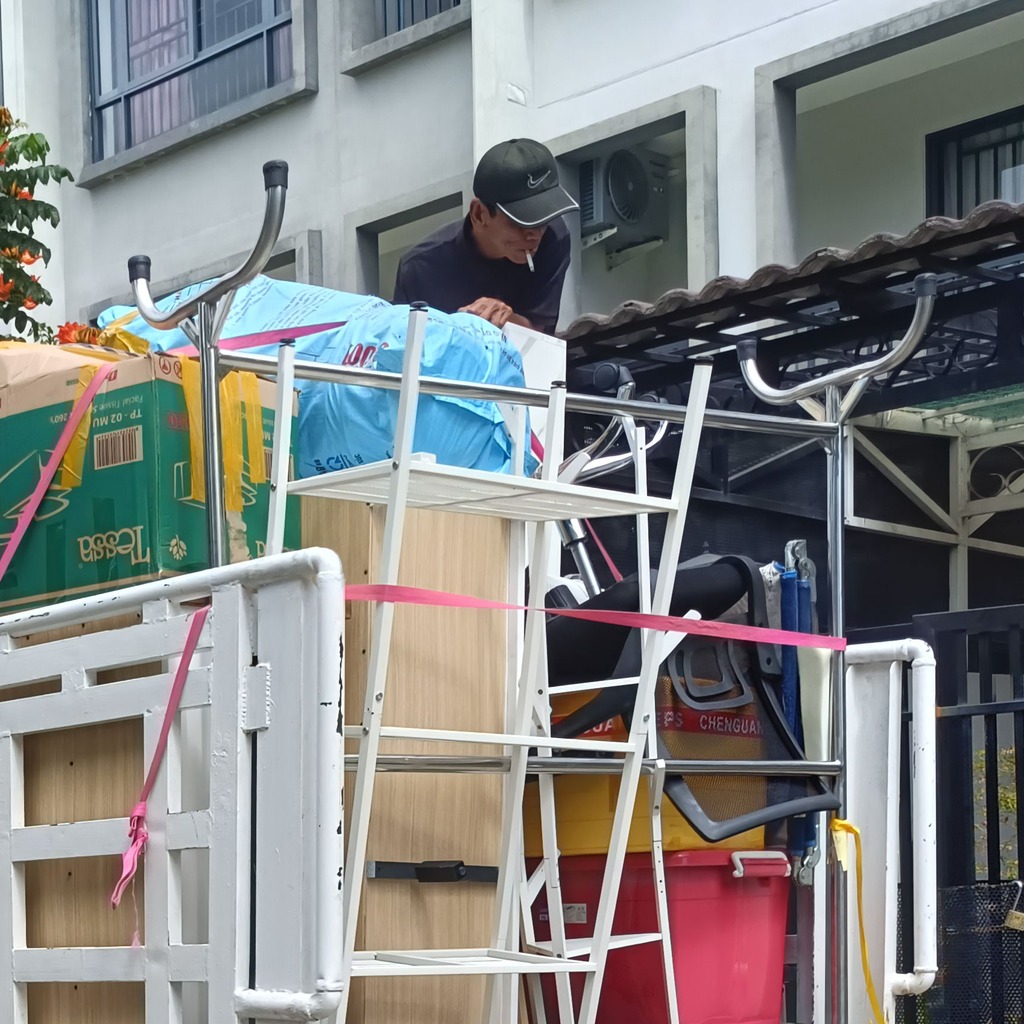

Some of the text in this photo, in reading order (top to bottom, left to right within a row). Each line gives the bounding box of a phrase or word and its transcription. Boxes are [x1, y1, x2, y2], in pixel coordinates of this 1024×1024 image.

[99, 400, 120, 411] Tissue
[121, 395, 143, 407] Facial
[110, 412, 123, 424] 02
[130, 408, 143, 420] TP
[92, 415, 109, 428] MU
[77, 526, 151, 566] Tessa
